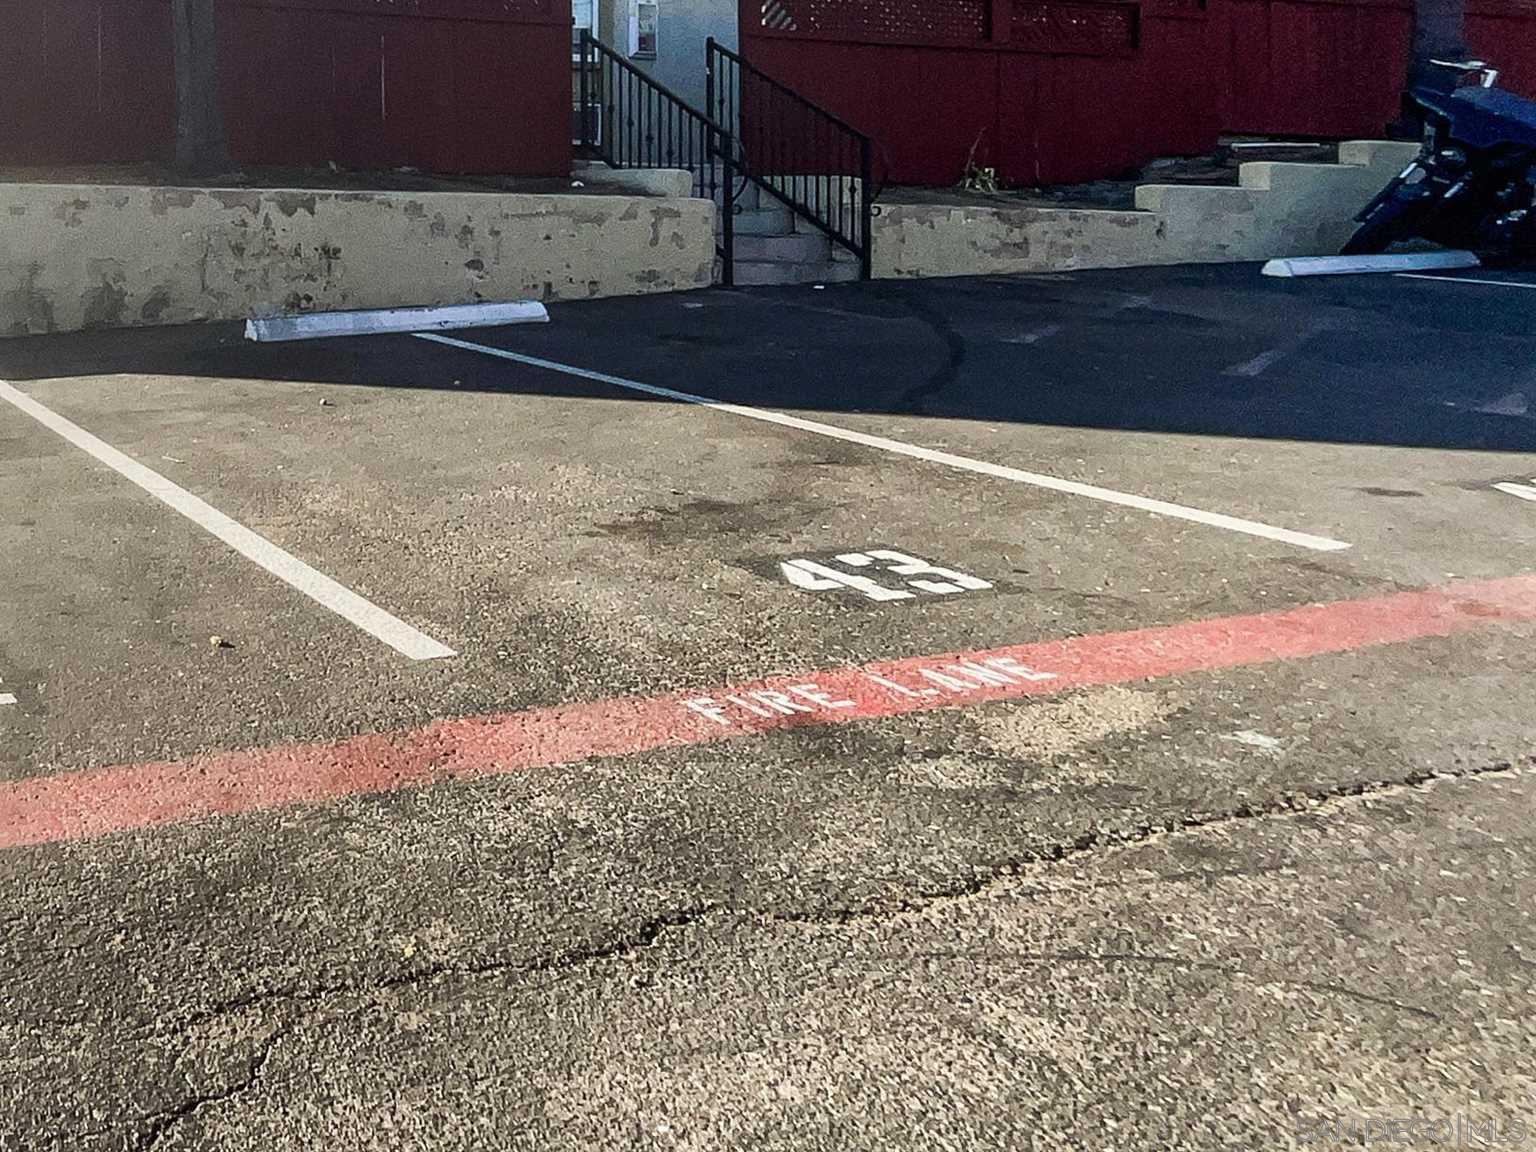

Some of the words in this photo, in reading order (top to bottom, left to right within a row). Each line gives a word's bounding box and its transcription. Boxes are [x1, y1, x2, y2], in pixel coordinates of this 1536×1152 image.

[780, 549, 994, 601] 43
[683, 682, 857, 725] FIRE
[865, 656, 1058, 699] LANE
